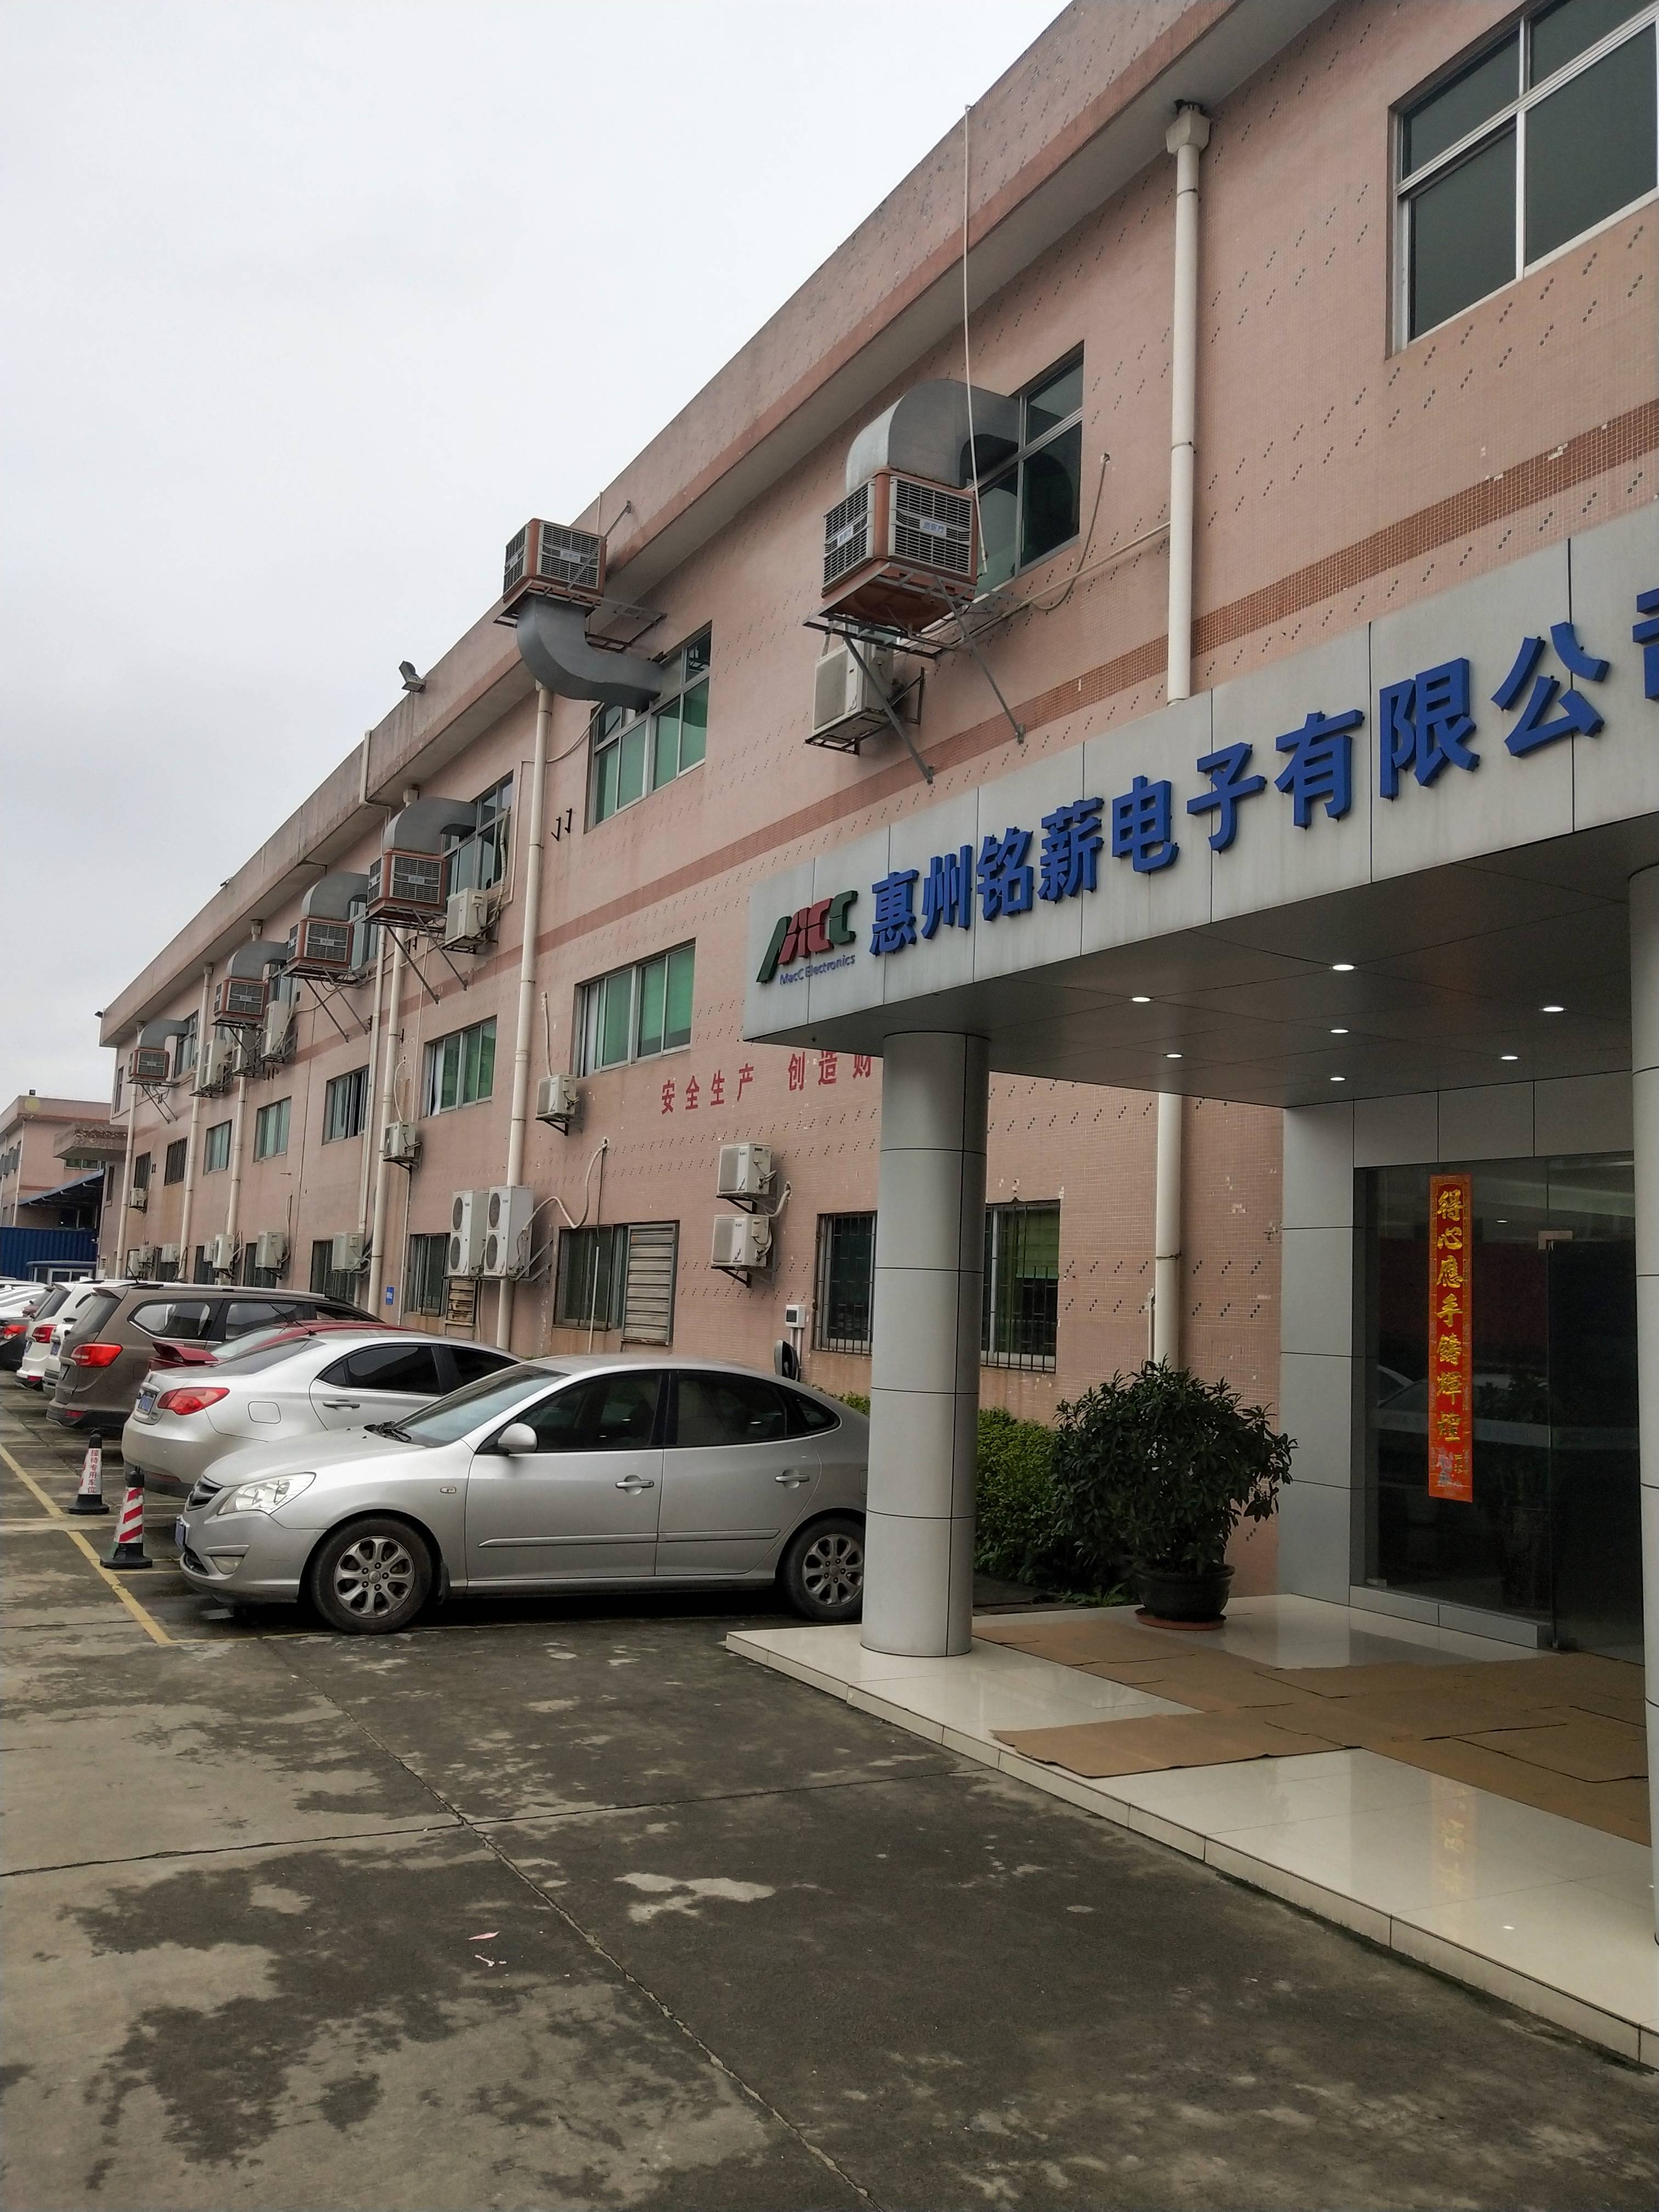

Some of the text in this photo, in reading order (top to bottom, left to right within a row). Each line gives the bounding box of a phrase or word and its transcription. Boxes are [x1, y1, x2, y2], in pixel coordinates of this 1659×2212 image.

[870, 588, 1659, 956] 惠州铭薪电子有限公
[805, 954, 856, 978] Electronics
[662, 1063, 754, 1115] 安全生产
[88, 1449, 98, 1493] 接待专用车位
